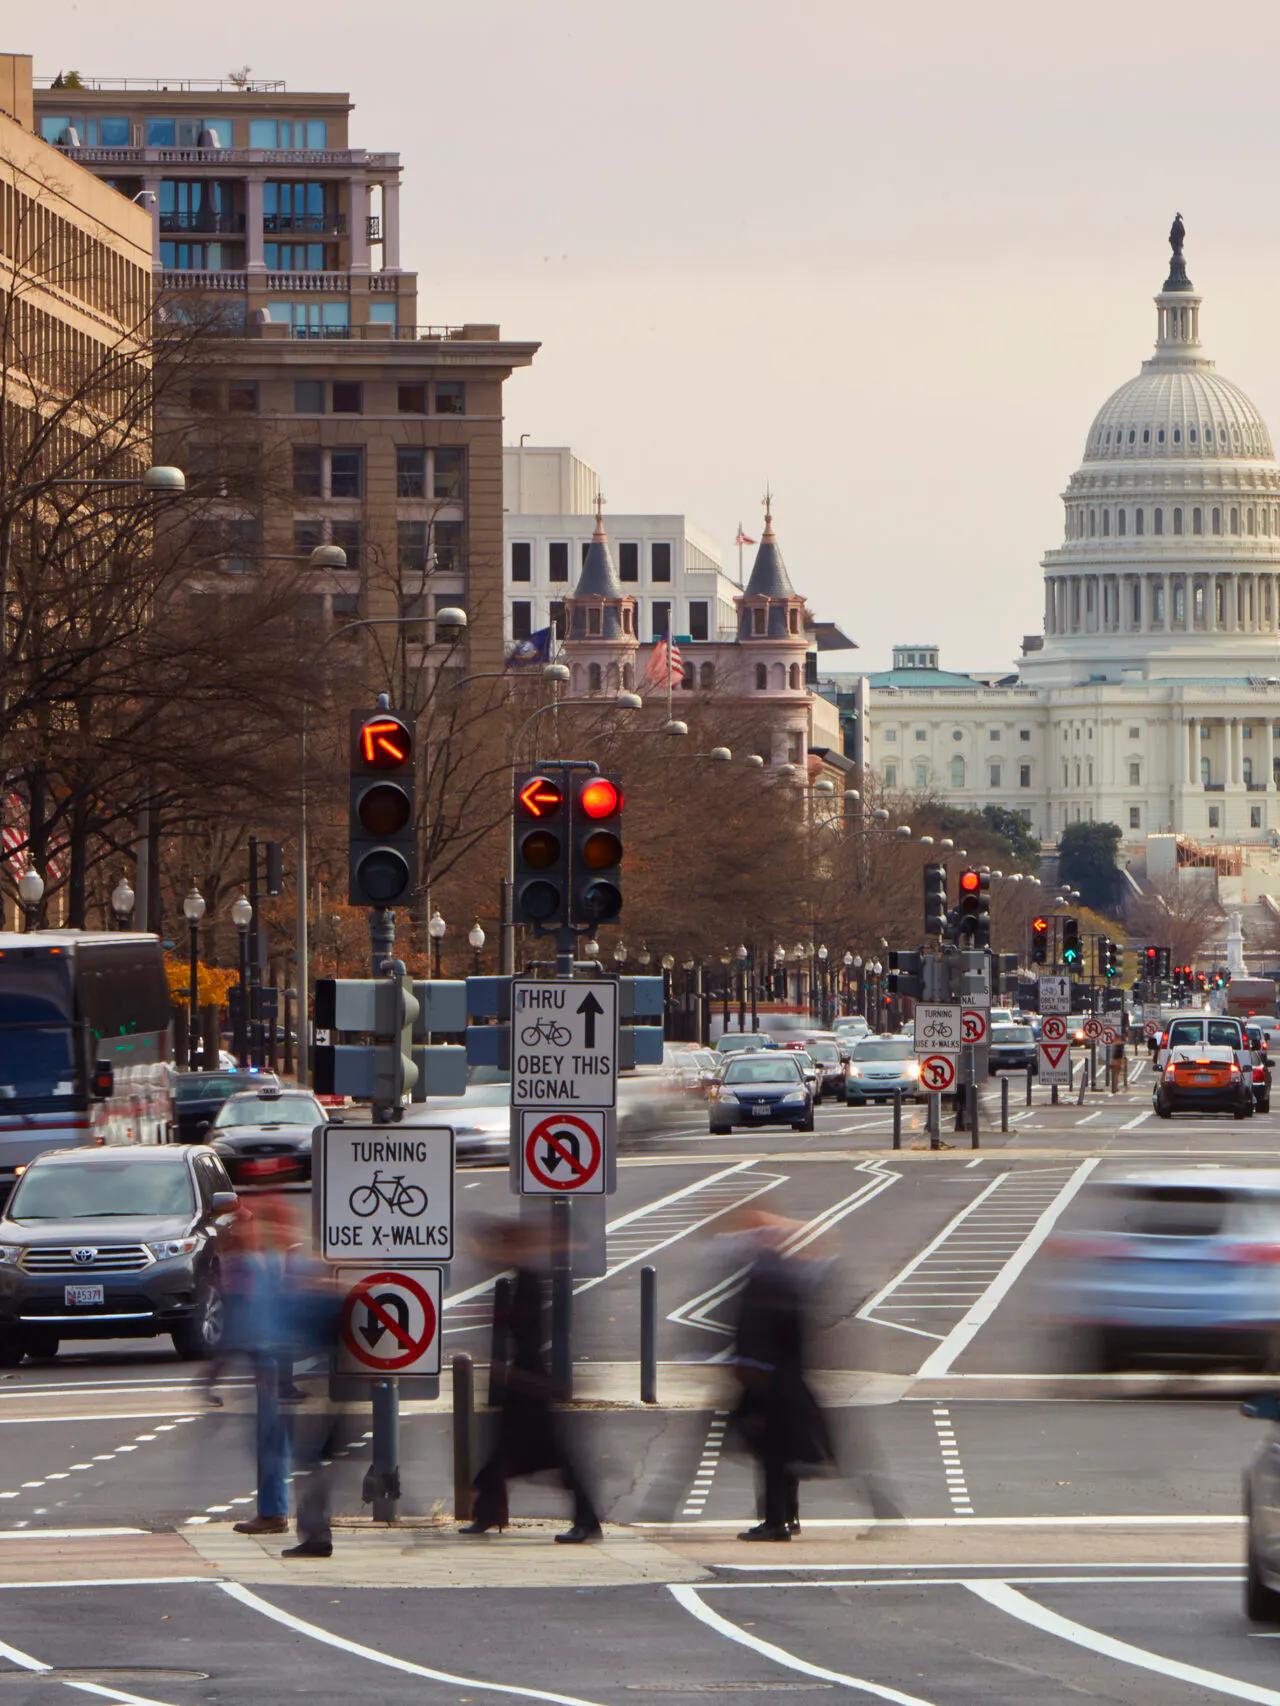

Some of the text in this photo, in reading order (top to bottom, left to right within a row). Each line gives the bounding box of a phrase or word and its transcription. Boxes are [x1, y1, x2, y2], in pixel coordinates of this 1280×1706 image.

[519, 989, 566, 1009] THRU
[925, 1010, 952, 1018] TURNING
[915, 1040, 960, 1048] USE X-WALKS
[517, 1055, 610, 1075] OBEY THIS
[517, 1079, 580, 1099] SIGNAL
[351, 1142, 427, 1162] TURNING
[328, 1225, 448, 1246] USE X-WALKS
